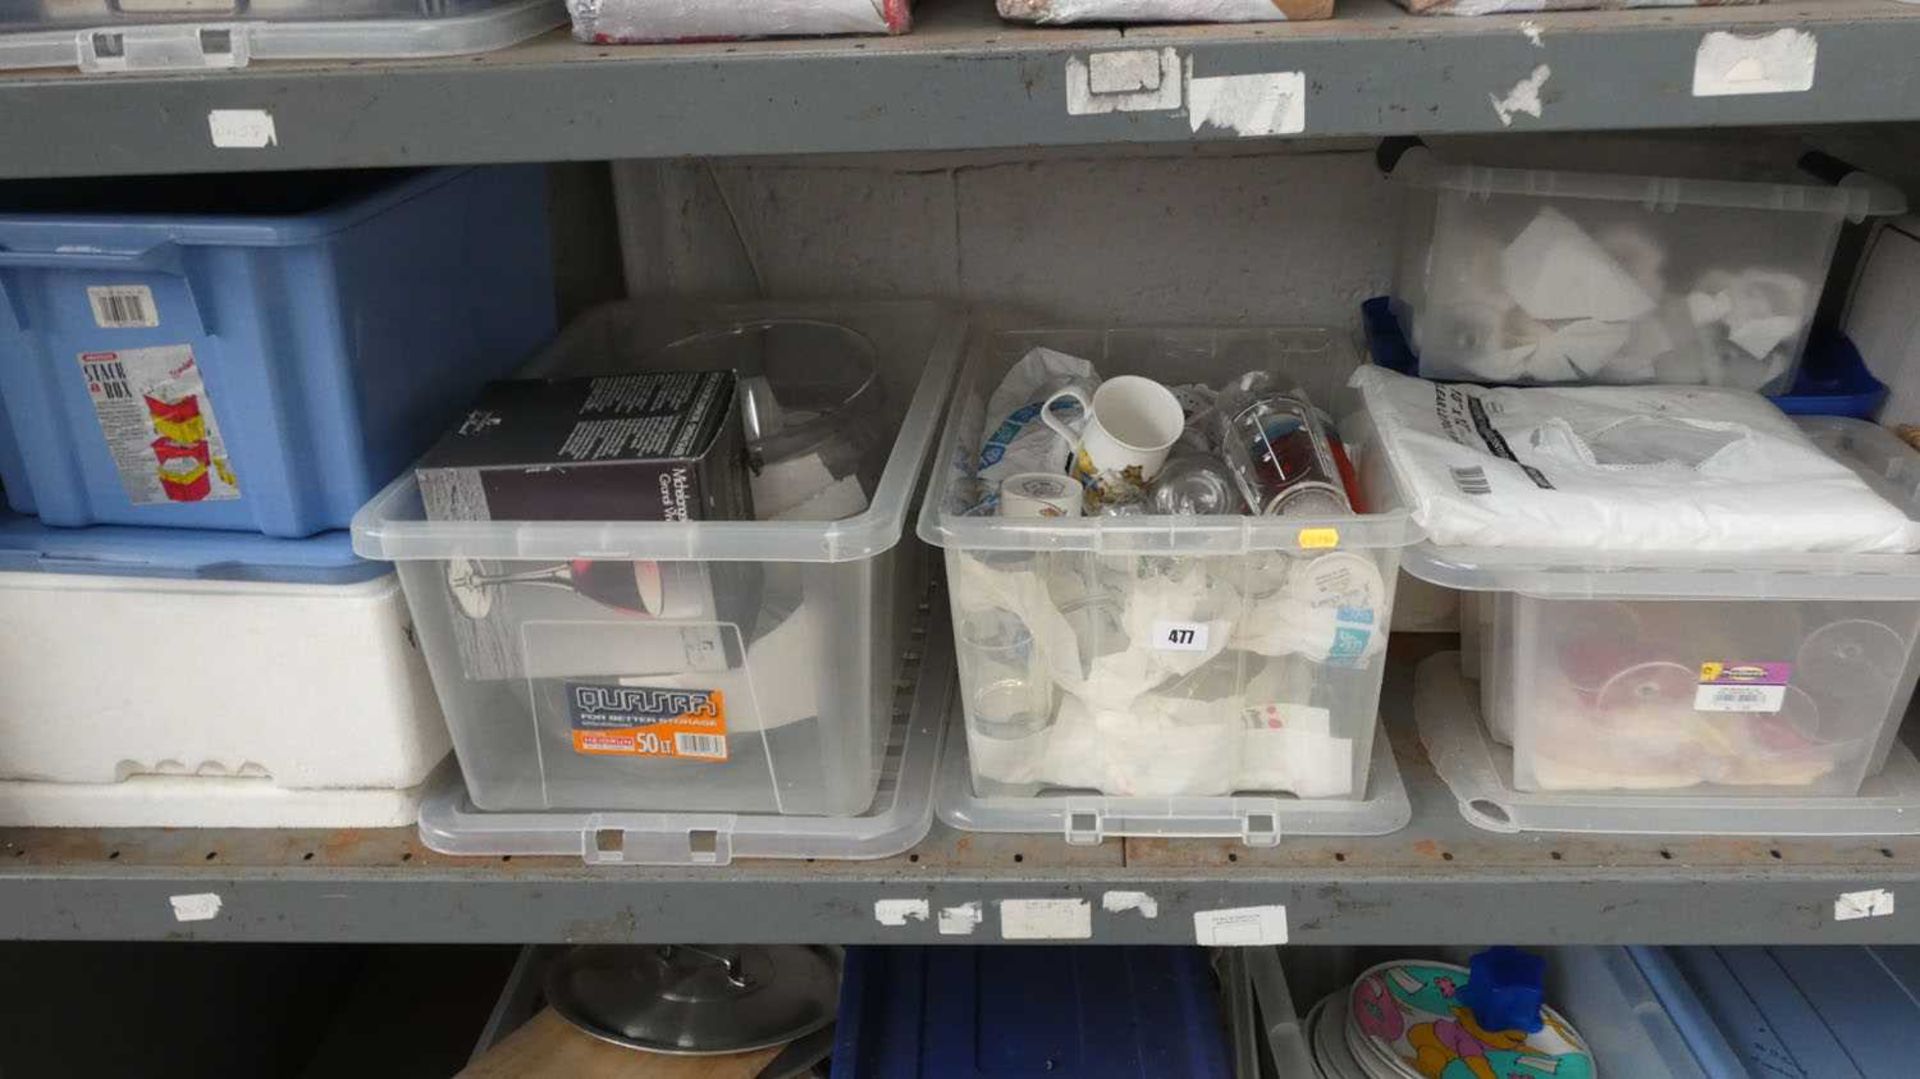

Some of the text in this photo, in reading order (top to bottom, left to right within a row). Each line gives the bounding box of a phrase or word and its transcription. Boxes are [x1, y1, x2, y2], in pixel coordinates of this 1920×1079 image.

[84, 362, 126, 382] STACK
[103, 380, 133, 399] BOX
[1168, 629, 1195, 644] 477
[576, 687, 717, 716] QUASAR
[608, 715, 657, 725] BETTER
[659, 717, 718, 727] STORAGE
[636, 732, 659, 753] 50
